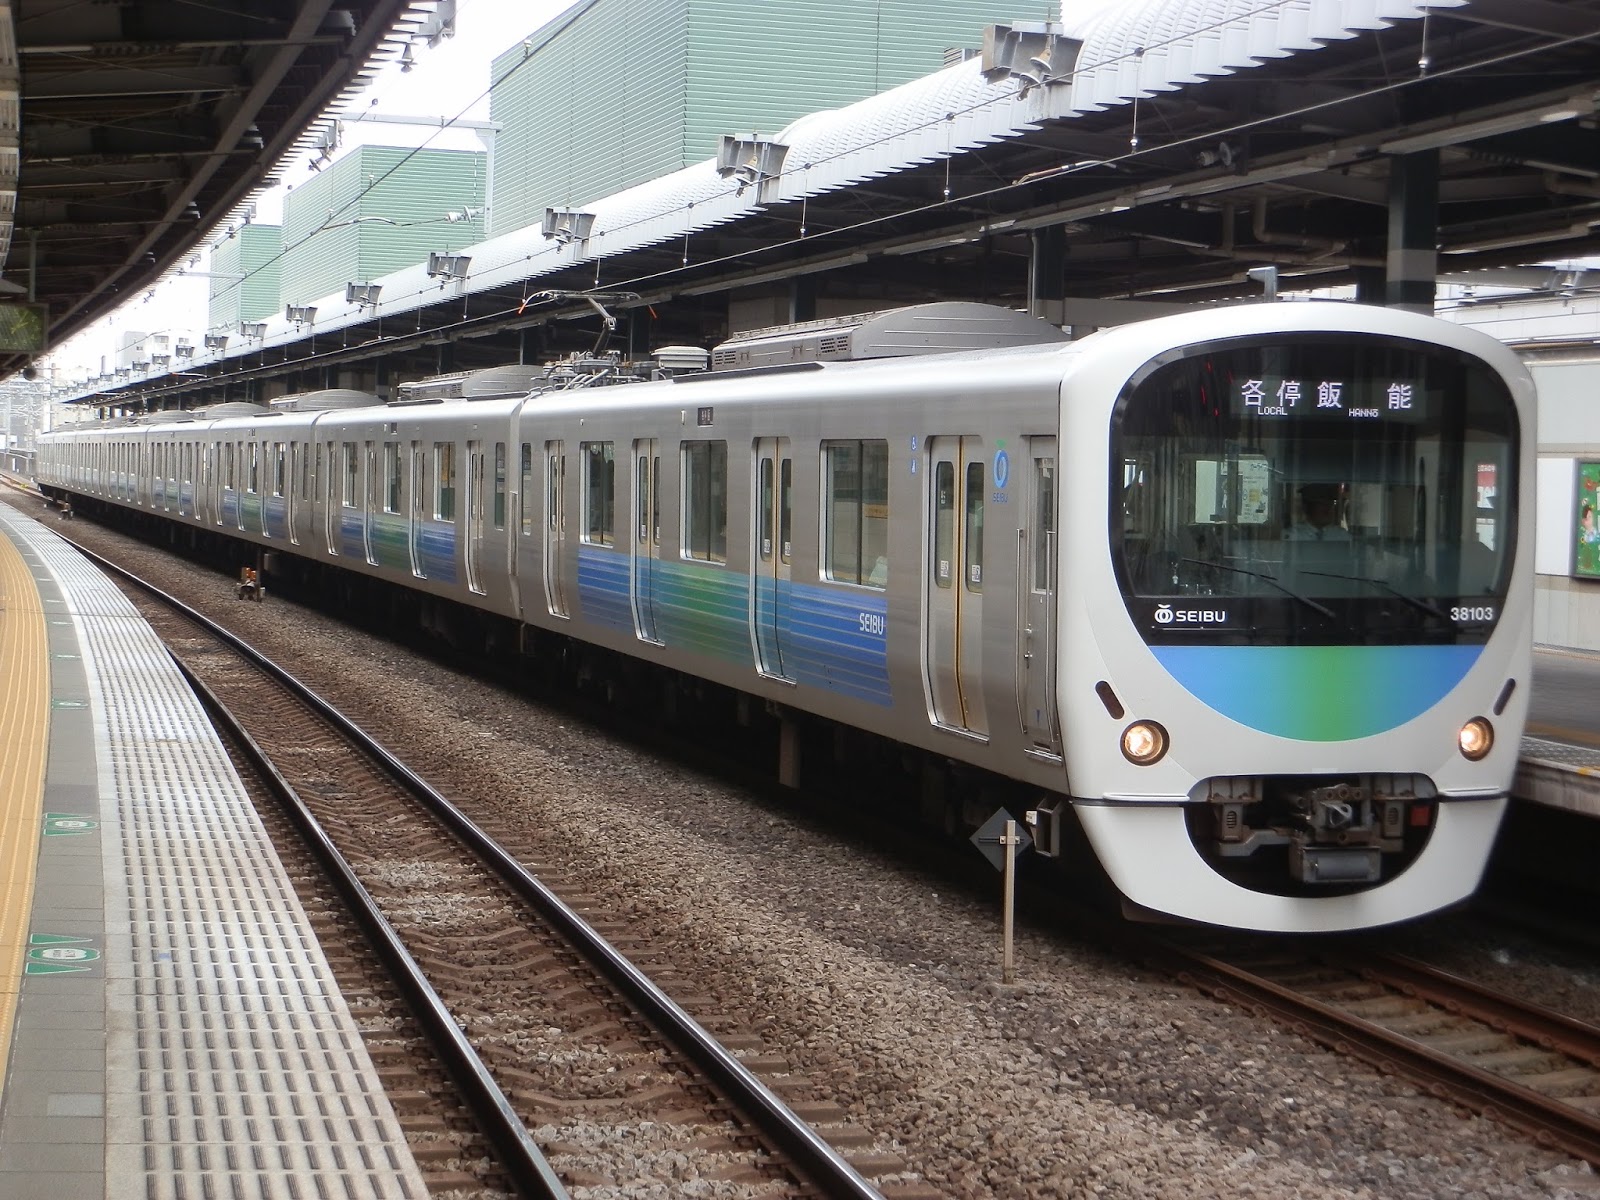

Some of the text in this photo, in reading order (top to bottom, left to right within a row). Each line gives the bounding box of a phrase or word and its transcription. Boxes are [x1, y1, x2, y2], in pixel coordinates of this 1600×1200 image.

[1257, 406, 1288, 416] LOCAL
[1175, 610, 1226, 622] SEIBU
[1450, 607, 1493, 621] 38103
[859, 612, 884, 636] SEIBU
